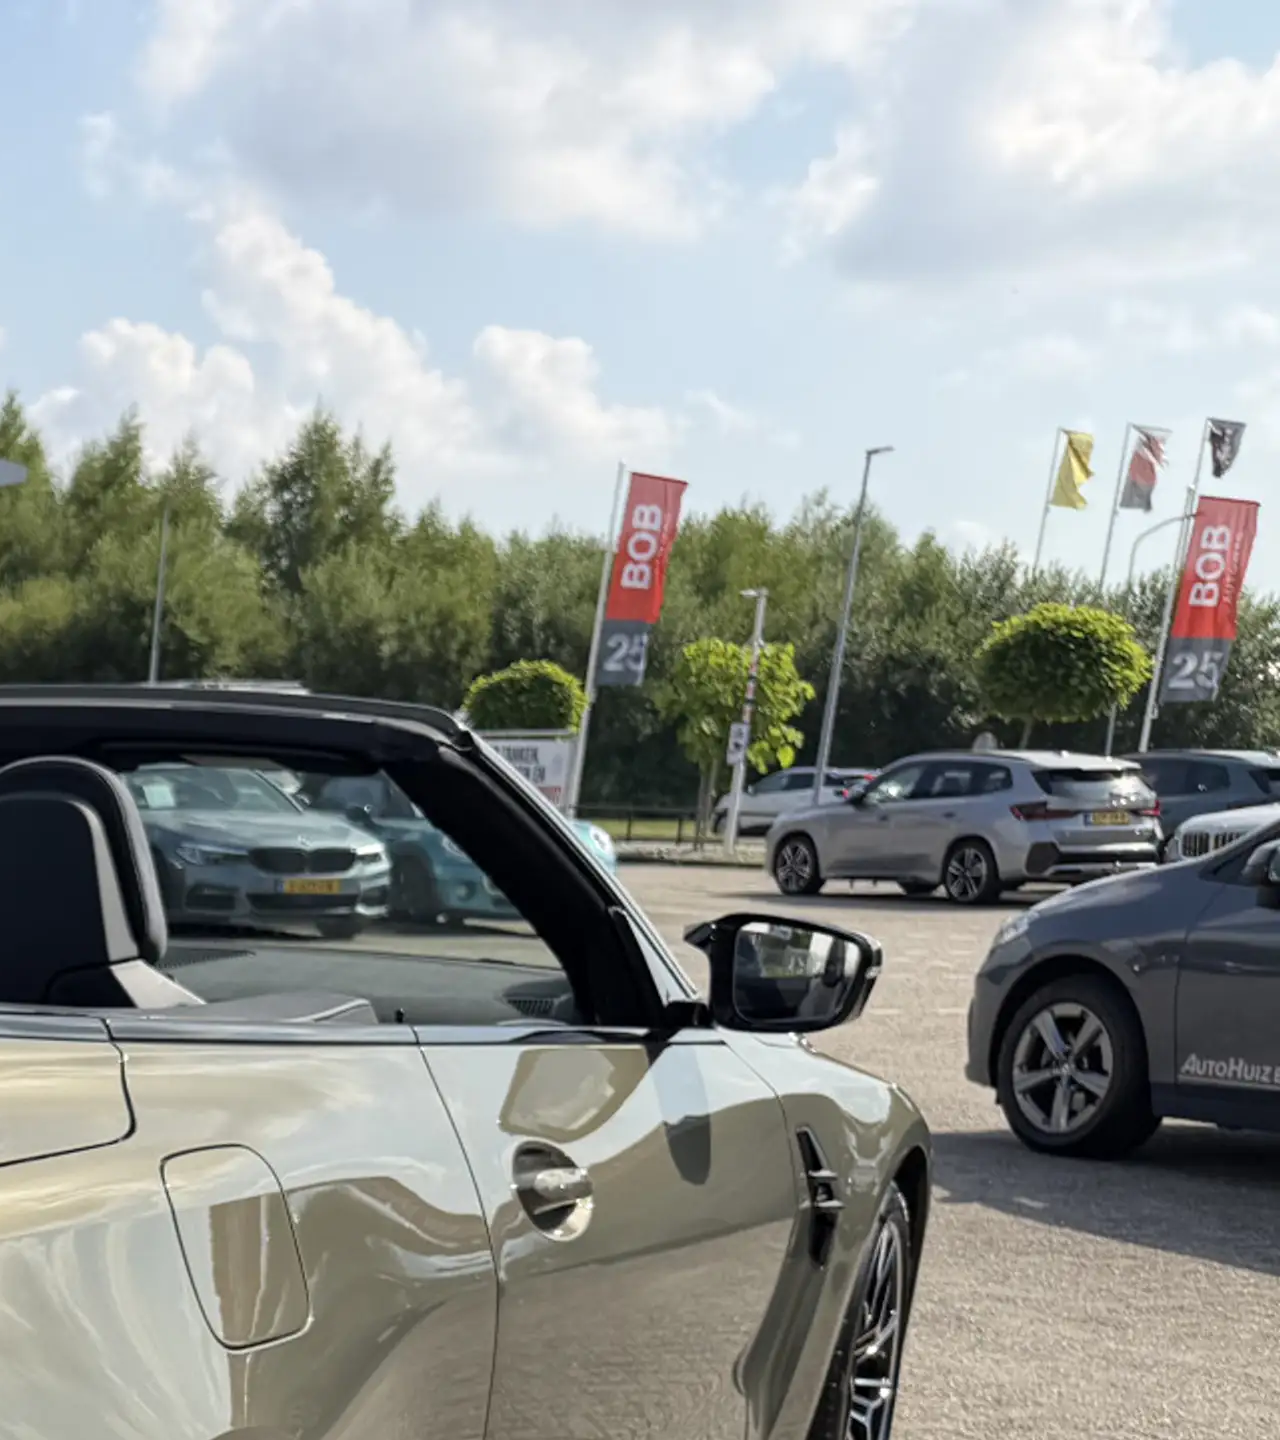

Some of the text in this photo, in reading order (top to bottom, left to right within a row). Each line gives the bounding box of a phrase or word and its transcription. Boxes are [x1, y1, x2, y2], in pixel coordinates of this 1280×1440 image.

[620, 504, 662, 590] BOB
[1189, 525, 1230, 607] BOB
[603, 633, 649, 672] 25
[1168, 652, 1224, 690] 25
